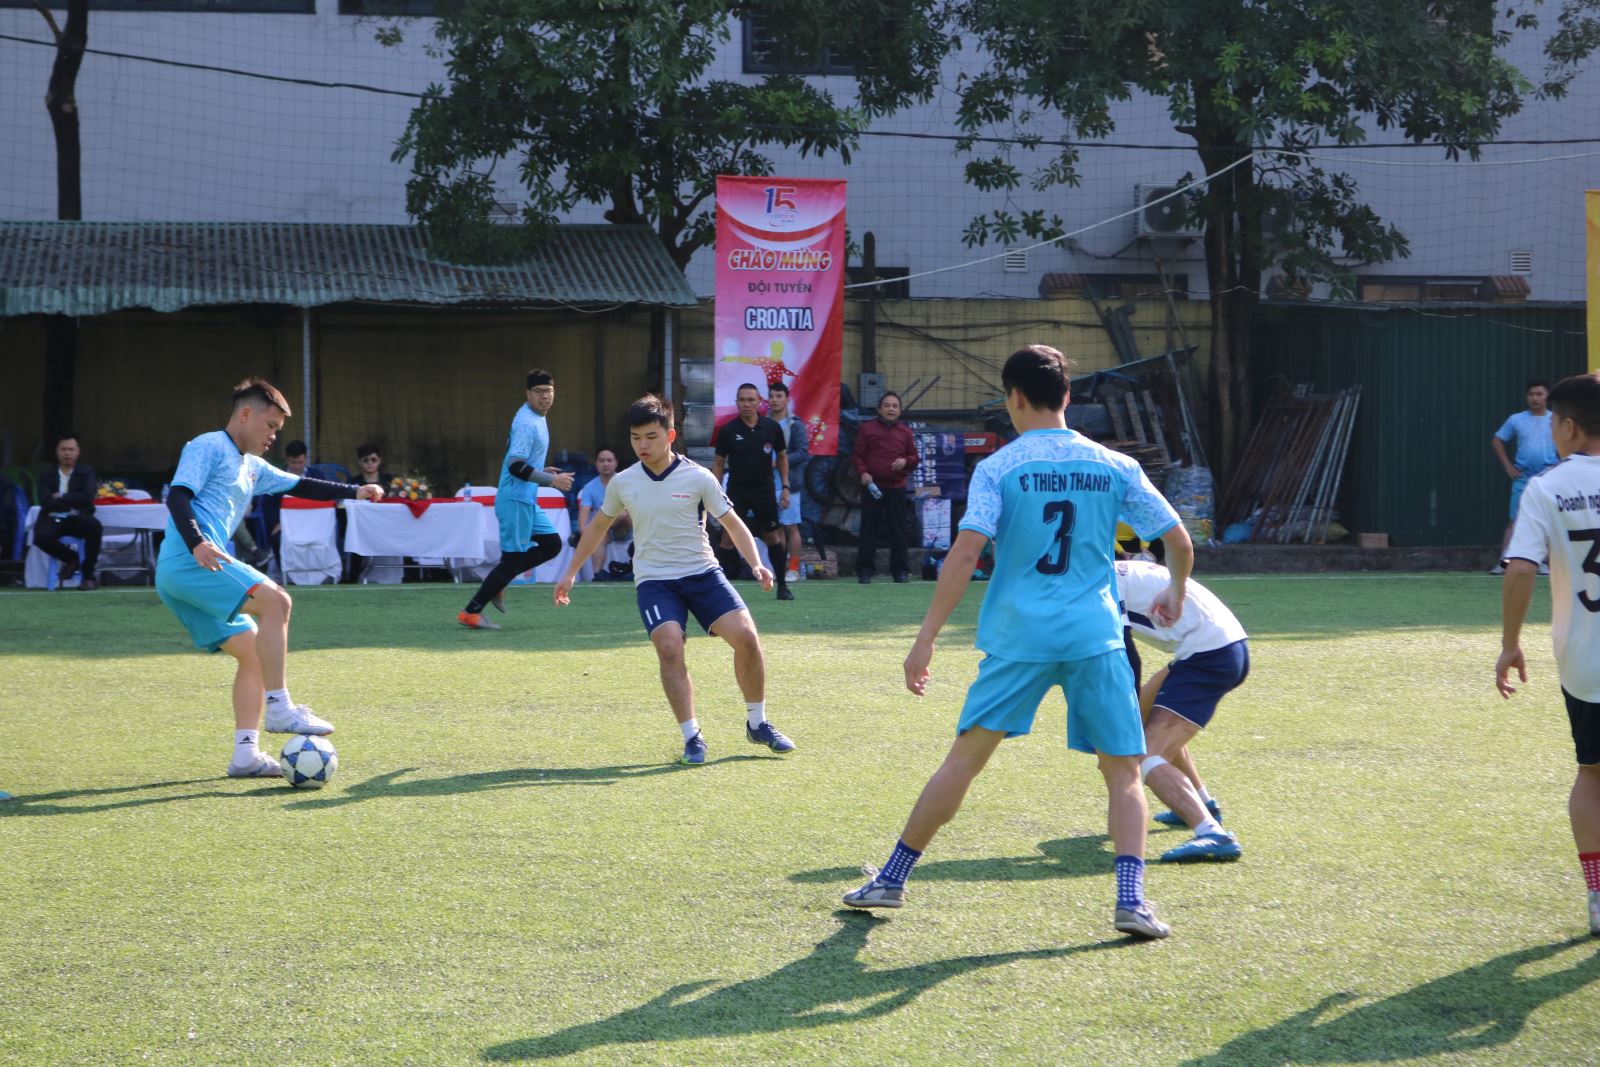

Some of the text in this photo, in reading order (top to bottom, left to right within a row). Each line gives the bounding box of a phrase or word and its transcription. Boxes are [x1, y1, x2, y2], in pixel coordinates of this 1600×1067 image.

[764, 187, 796, 213] 15
[745, 307, 814, 331] CROATIA
[1033, 470, 1067, 492] THIÊN
[1070, 472, 1111, 492] THANH
[1556, 490, 1587, 512] Doanh
[1036, 500, 1077, 576] 3
[1567, 528, 1600, 613] 3
[645, 605, 661, 625] 11
